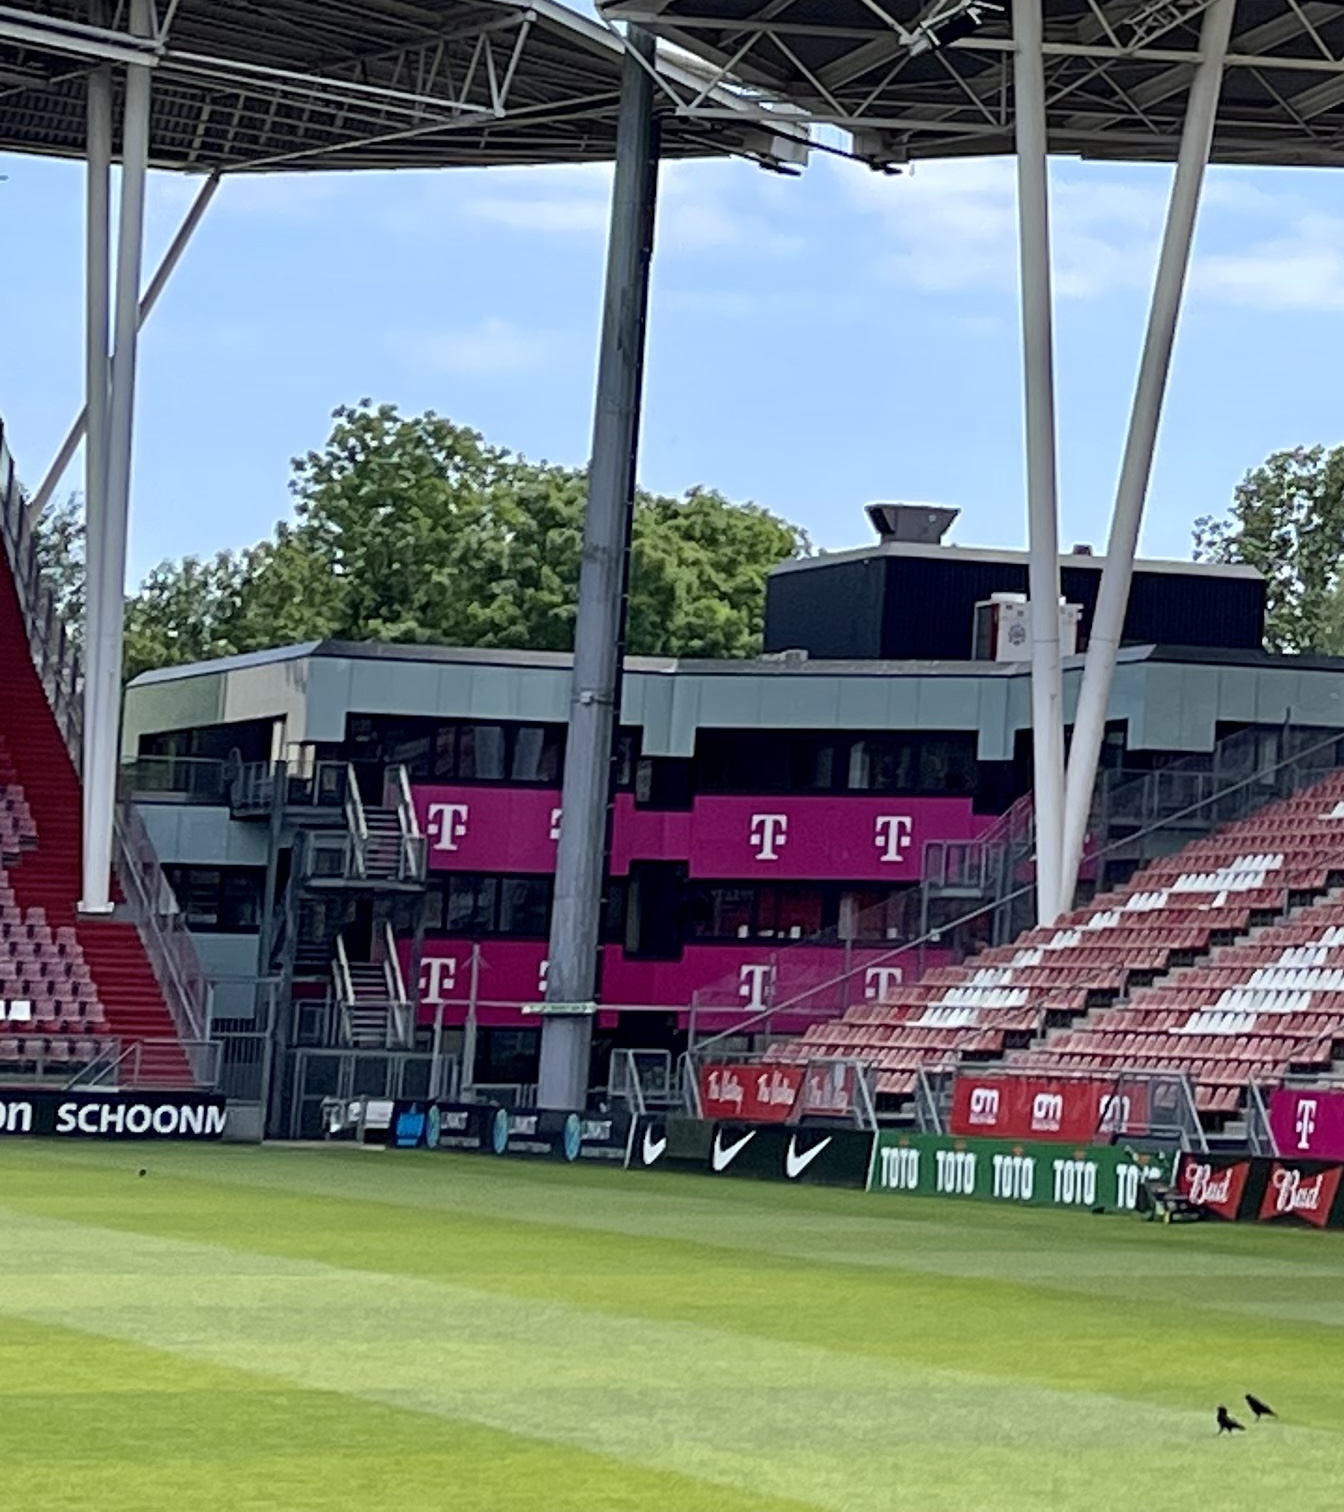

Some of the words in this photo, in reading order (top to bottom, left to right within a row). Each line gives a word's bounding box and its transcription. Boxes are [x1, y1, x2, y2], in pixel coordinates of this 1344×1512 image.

[56, 1102, 226, 1134] SCHOONM
[881, 1146, 920, 1190] TOTO
[936, 1150, 977, 1195] TOTO
[992, 1154, 1036, 1200] TOTO
[1053, 1159, 1098, 1205] TOTO
[1185, 1163, 1232, 1205] Bud
[1272, 1169, 1324, 1212] Bud
